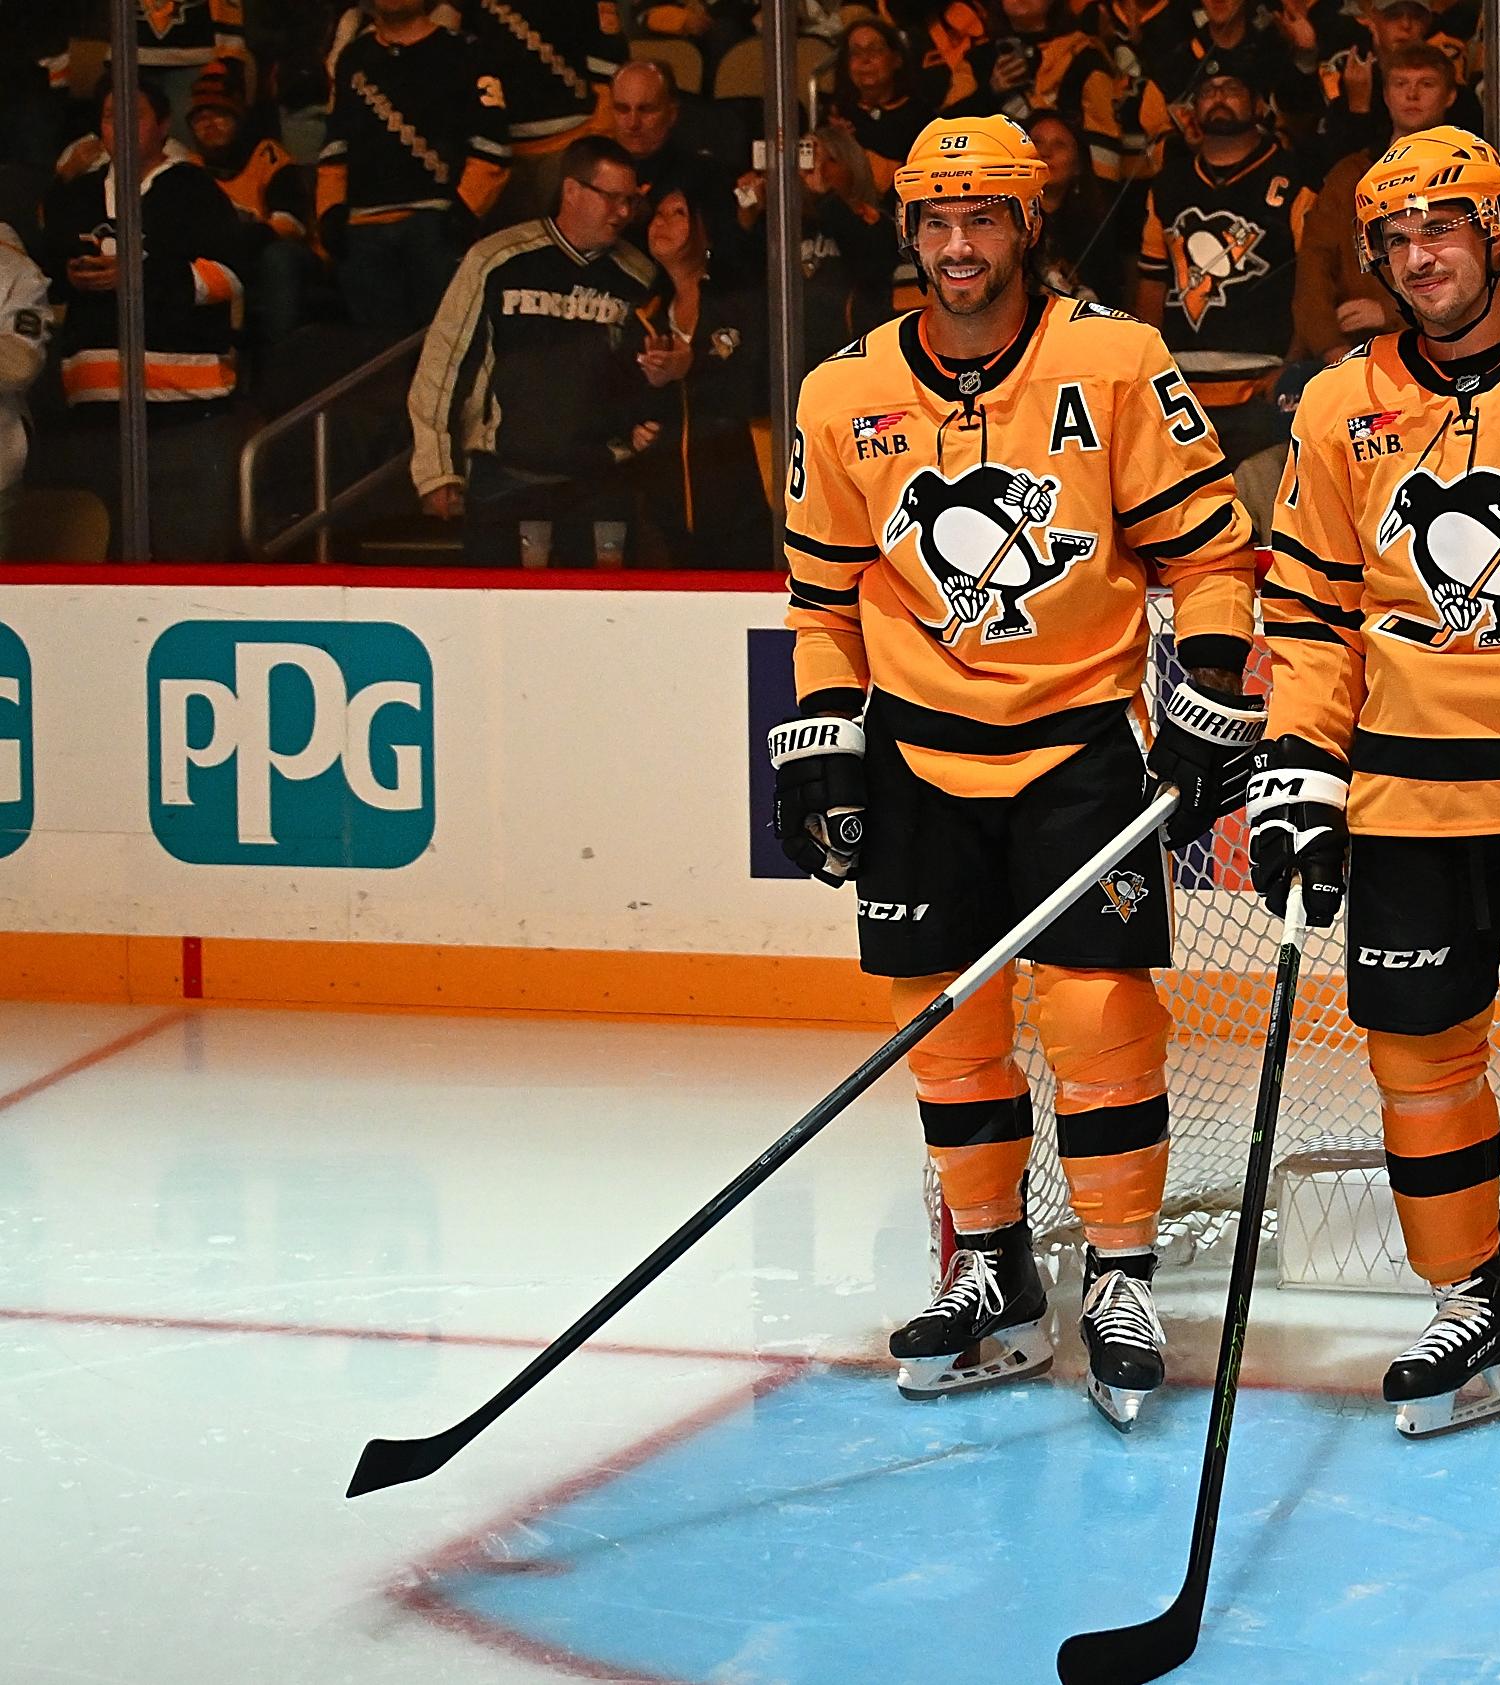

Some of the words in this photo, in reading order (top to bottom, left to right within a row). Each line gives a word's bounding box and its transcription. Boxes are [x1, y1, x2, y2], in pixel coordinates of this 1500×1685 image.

[475, 75, 506, 110] 3
[939, 136, 968, 150] 58
[930, 170, 973, 179] BAUER
[1377, 174, 1416, 192] CCM
[1265, 176, 1289, 207] C
[1048, 381, 1102, 456] A
[1149, 368, 1208, 446] 5
[856, 433, 910, 461] F.N.B.
[1352, 433, 1404, 462] F.N.B.
[1167, 692, 1267, 742] WARRIO
[160, 642, 422, 845] PPG
[1253, 754, 1269, 768] 87
[1247, 778, 1305, 802] CM
[1312, 883, 1339, 894] CCM
[858, 899, 930, 921] CCM
[1358, 946, 1451, 968] CCM
[1467, 1336, 1496, 1367] CCM
